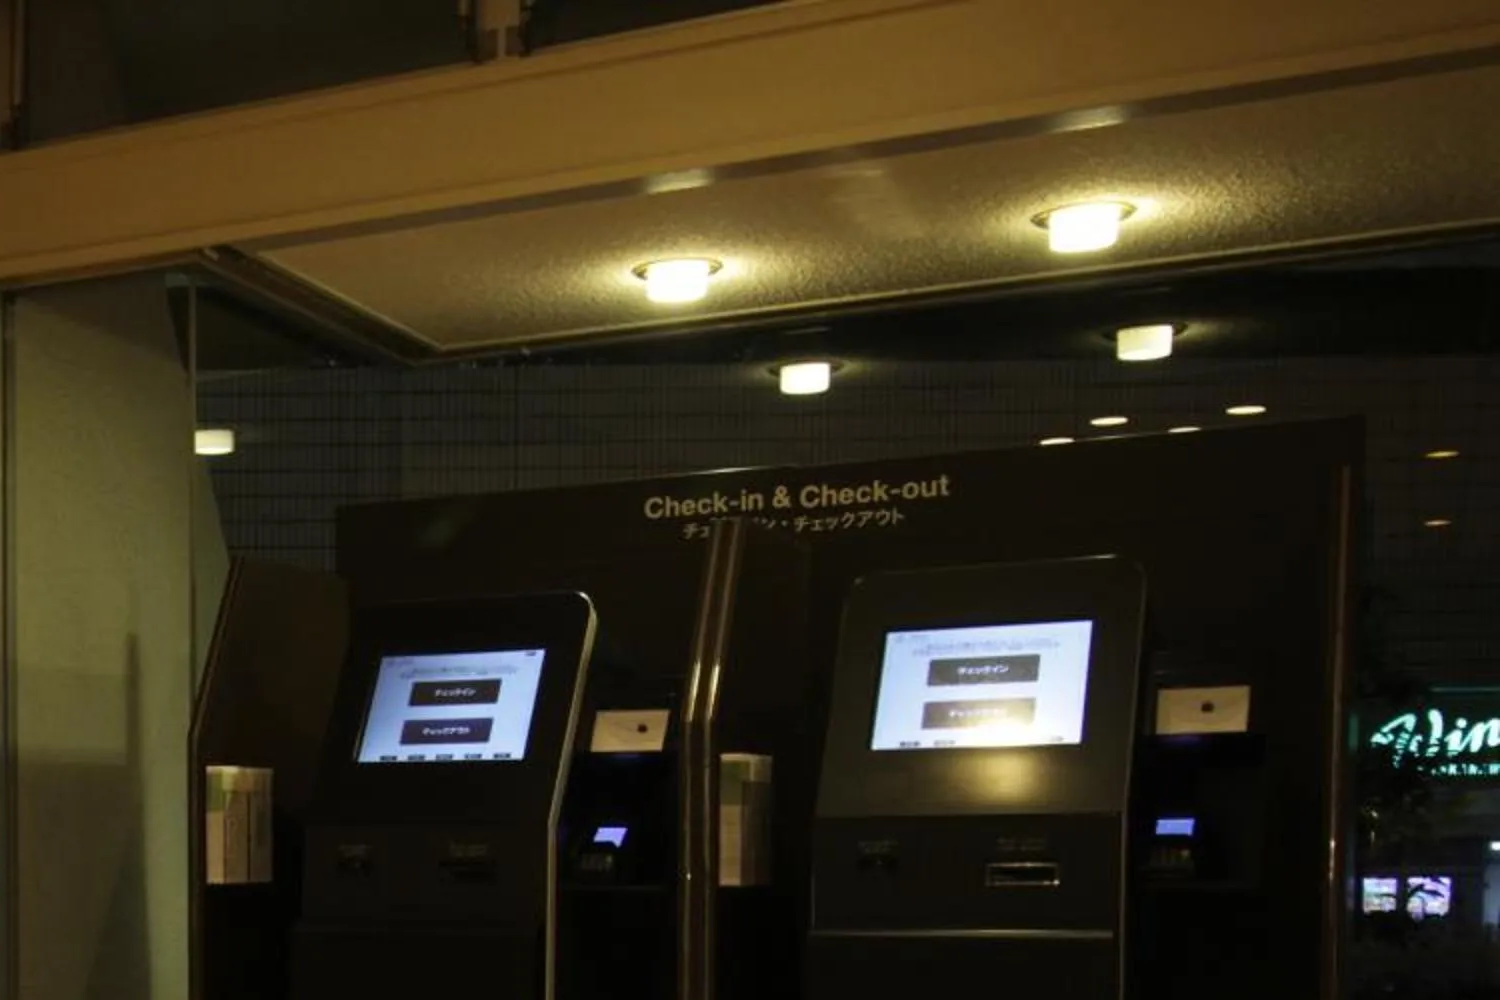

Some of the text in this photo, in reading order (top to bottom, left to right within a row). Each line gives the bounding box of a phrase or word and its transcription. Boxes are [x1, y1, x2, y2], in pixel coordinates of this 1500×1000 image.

[643, 473, 951, 520] Check-in & Check-out
